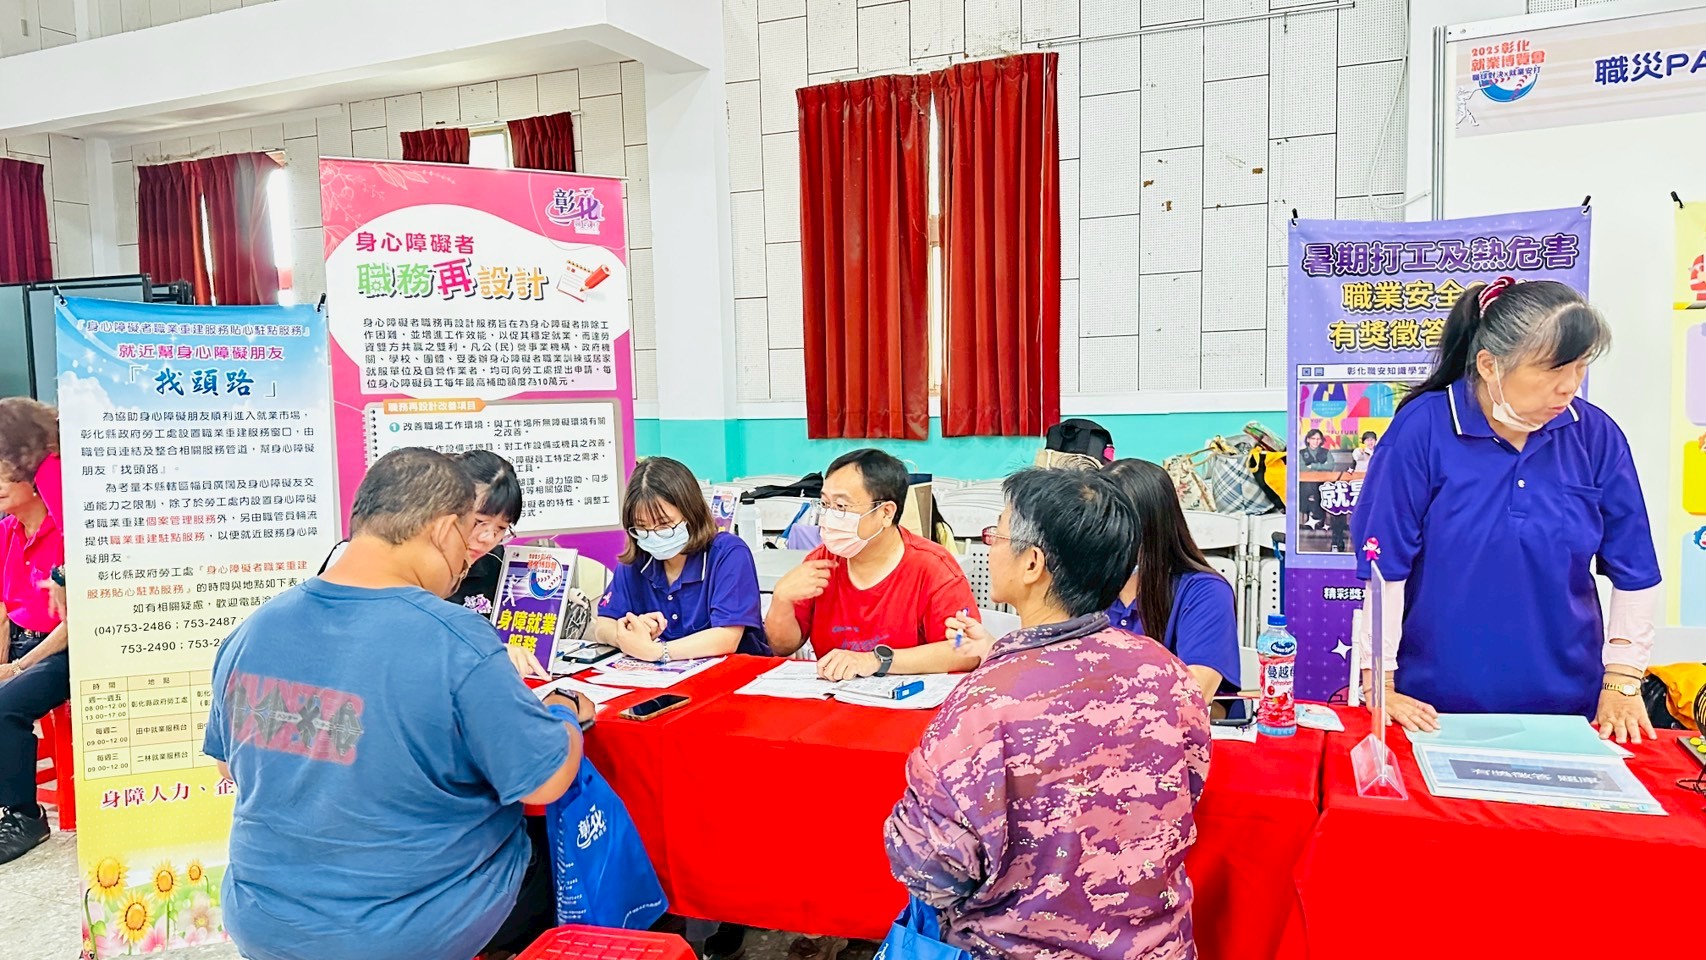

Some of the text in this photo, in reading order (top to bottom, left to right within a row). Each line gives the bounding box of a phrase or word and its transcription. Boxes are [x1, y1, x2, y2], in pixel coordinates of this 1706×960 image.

[555, 188, 599, 220] 彰化
[356, 231, 475, 255] 身心障礙者
[1302, 233, 1579, 277] 暑期打工及熱危害
[356, 257, 549, 300] 職務再設計
[1342, 279, 1487, 313] 職業安全
[1330, 318, 1443, 351] 有獎徵答
[118, 343, 284, 361] 就近幫身心障礙朋友
[1347, 366, 1428, 376] 彰化職安知識學堂
[80, 427, 314, 440] 彰化縣政府勞工處設置職業重建服務窗口，由
[494, 428, 529, 437] 之改善。
[521, 485, 579, 495] 等相關協助。
[1323, 587, 1366, 601] 精彩獎
[497, 609, 557, 635] 身障就業
